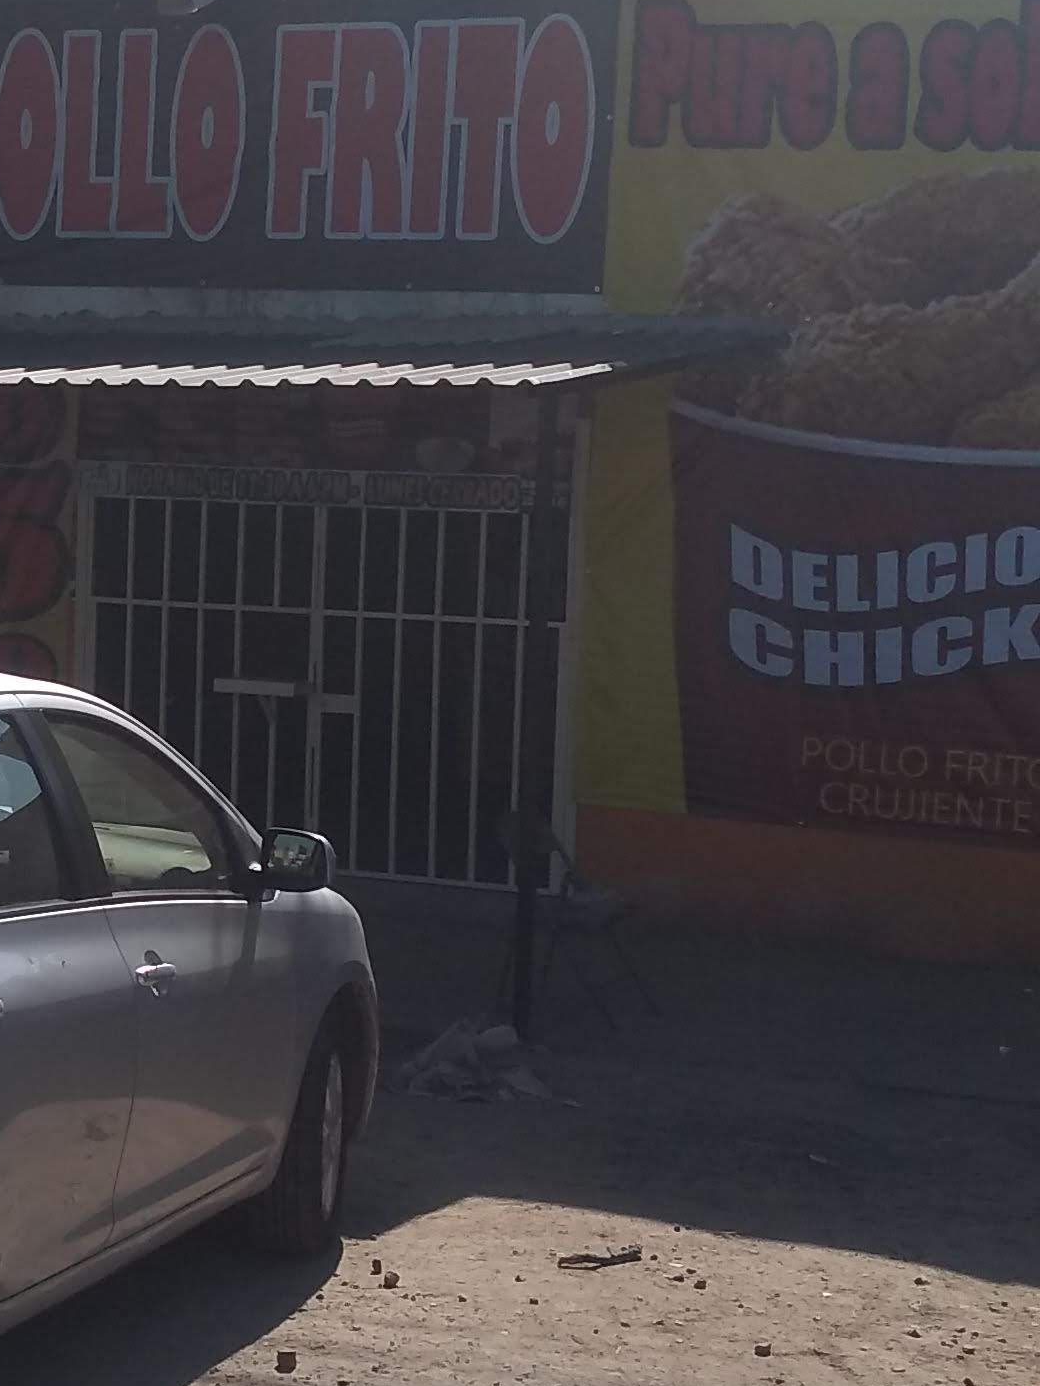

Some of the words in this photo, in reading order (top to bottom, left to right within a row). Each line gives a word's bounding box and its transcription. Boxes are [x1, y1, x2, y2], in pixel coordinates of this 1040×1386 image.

[266, 12, 596, 245] FRITO
[730, 523, 1040, 612] DELICIO
[729, 604, 1040, 686] CHICK
[801, 736, 929, 779] POLLO
[819, 781, 1033, 834] CRUJIENTE
